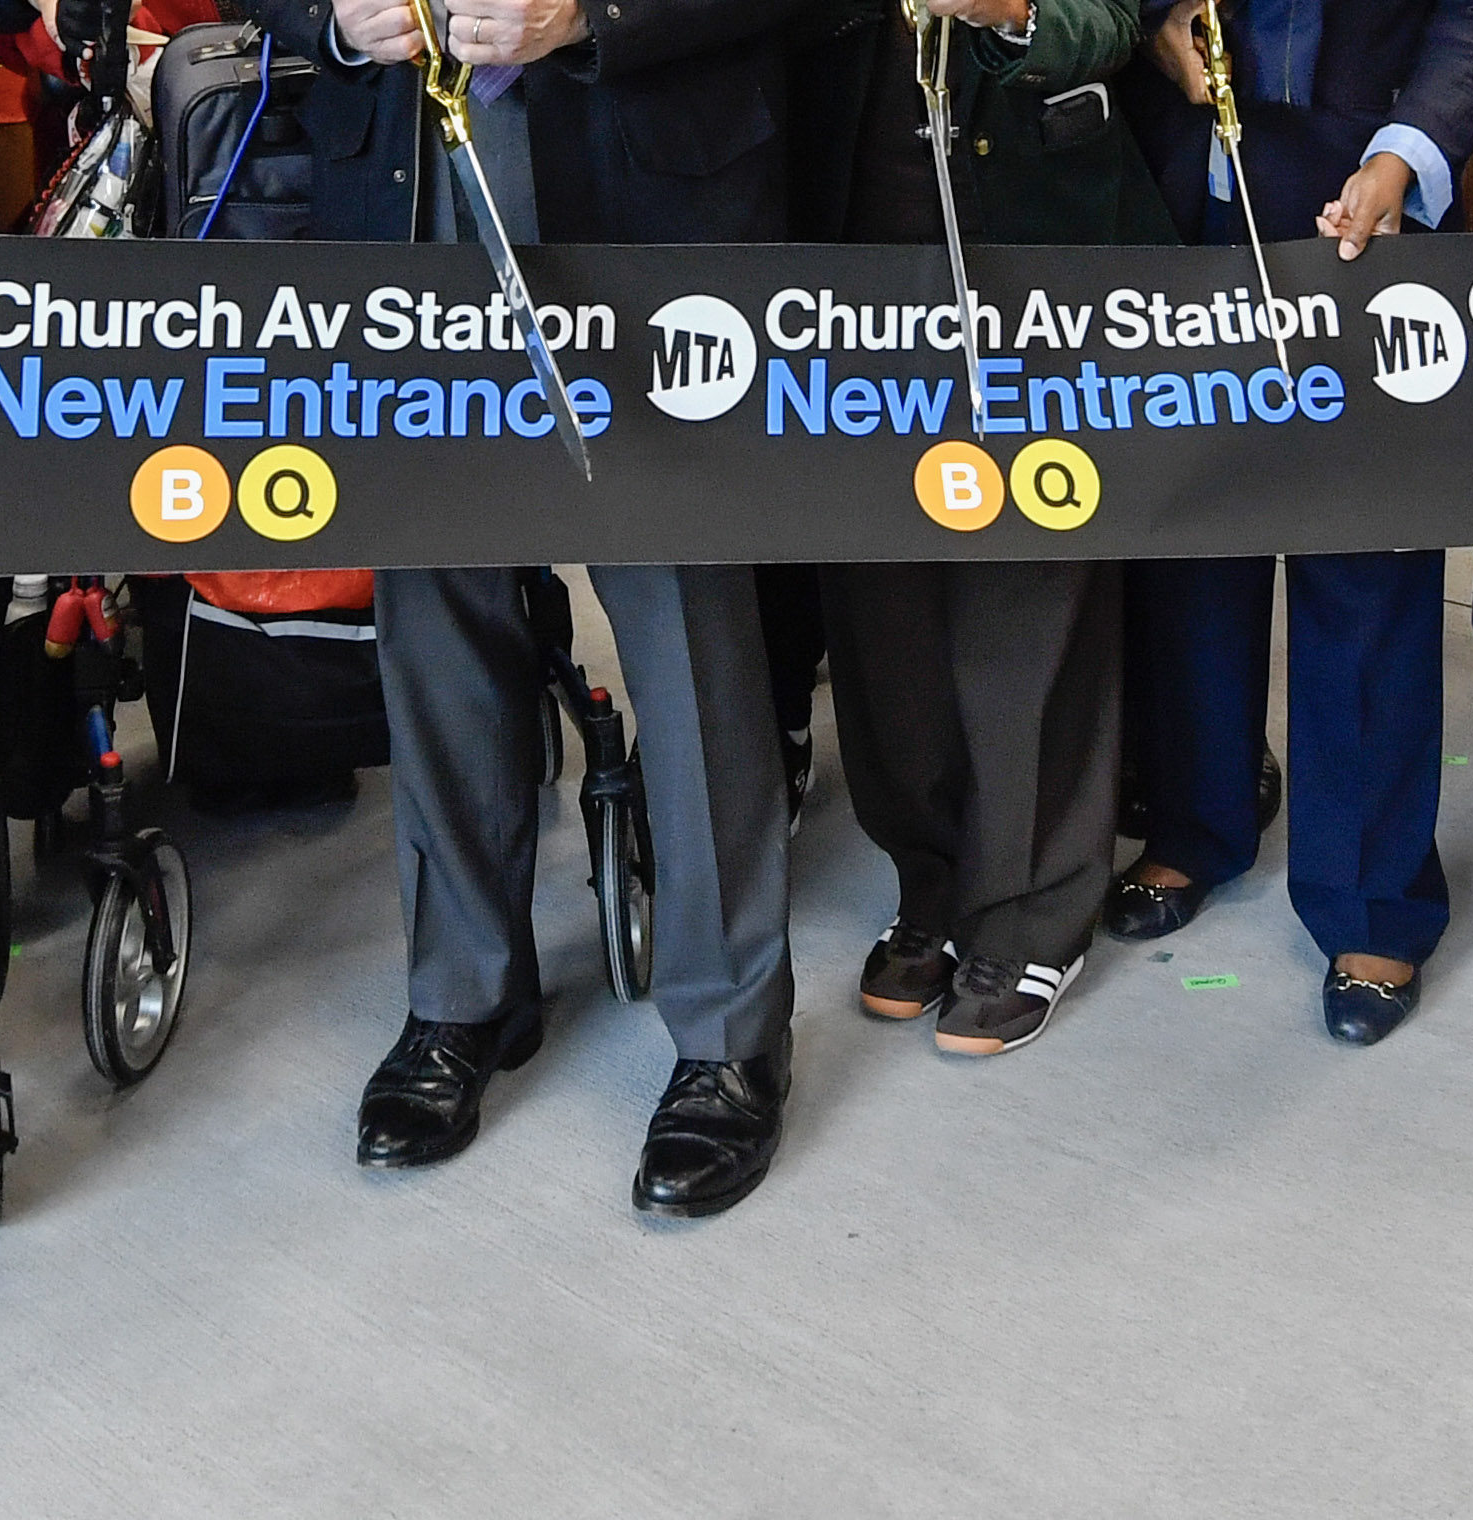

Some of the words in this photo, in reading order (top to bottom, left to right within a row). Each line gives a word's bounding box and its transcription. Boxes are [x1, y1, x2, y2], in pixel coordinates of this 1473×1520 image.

[255, 286, 351, 350] Av
[765, 288, 1001, 351] Church
[1013, 289, 1093, 349] Av
[1104, 289, 1340, 349] Station
[203, 356, 613, 440] Entrance
[766, 358, 954, 437] New
[972, 357, 1346, 434] Entrance
[161, 469, 205, 521] B
[264, 469, 314, 519] Q
[940, 462, 983, 511] B
[1034, 461, 1082, 509] Q
